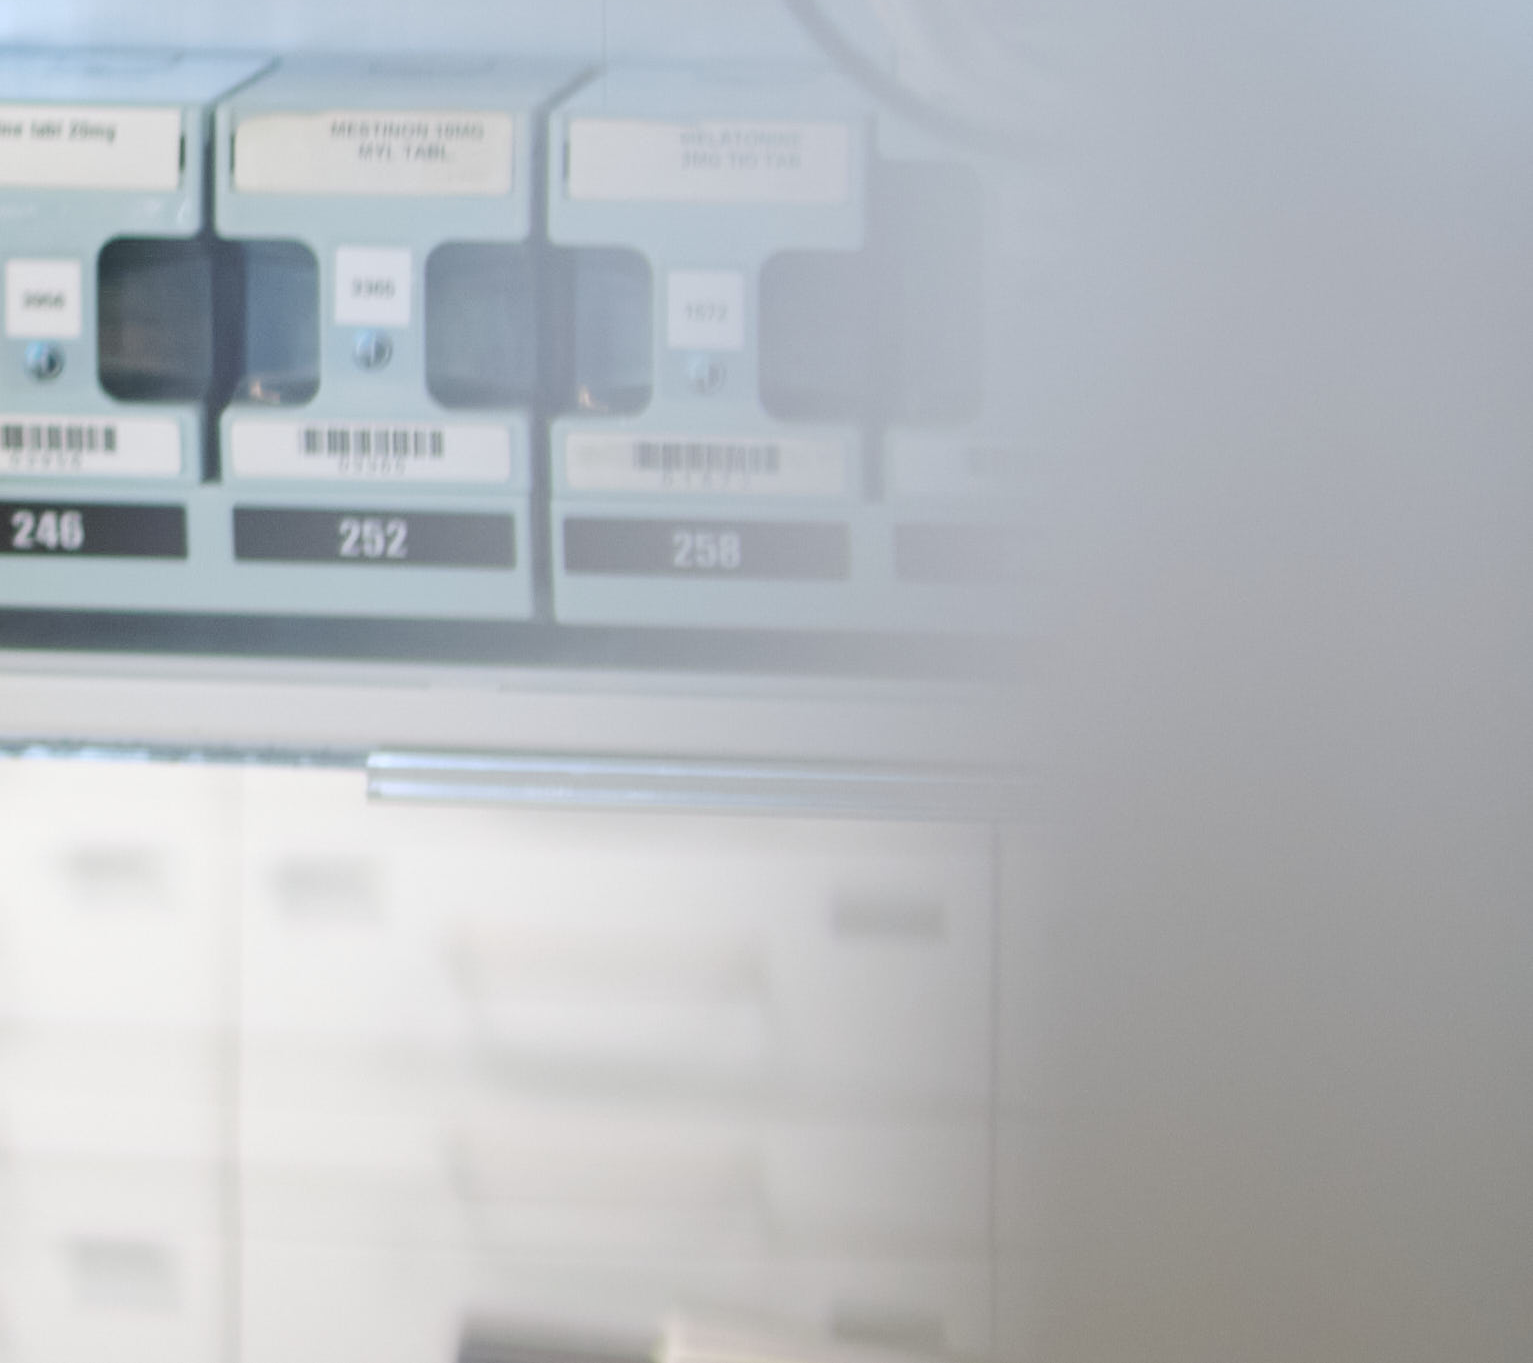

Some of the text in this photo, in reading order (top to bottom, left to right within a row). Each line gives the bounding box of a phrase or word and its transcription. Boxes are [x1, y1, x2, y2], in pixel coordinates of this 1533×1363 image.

[11, 509, 86, 551] 246
[338, 517, 409, 559] 252
[671, 529, 743, 571] 258
